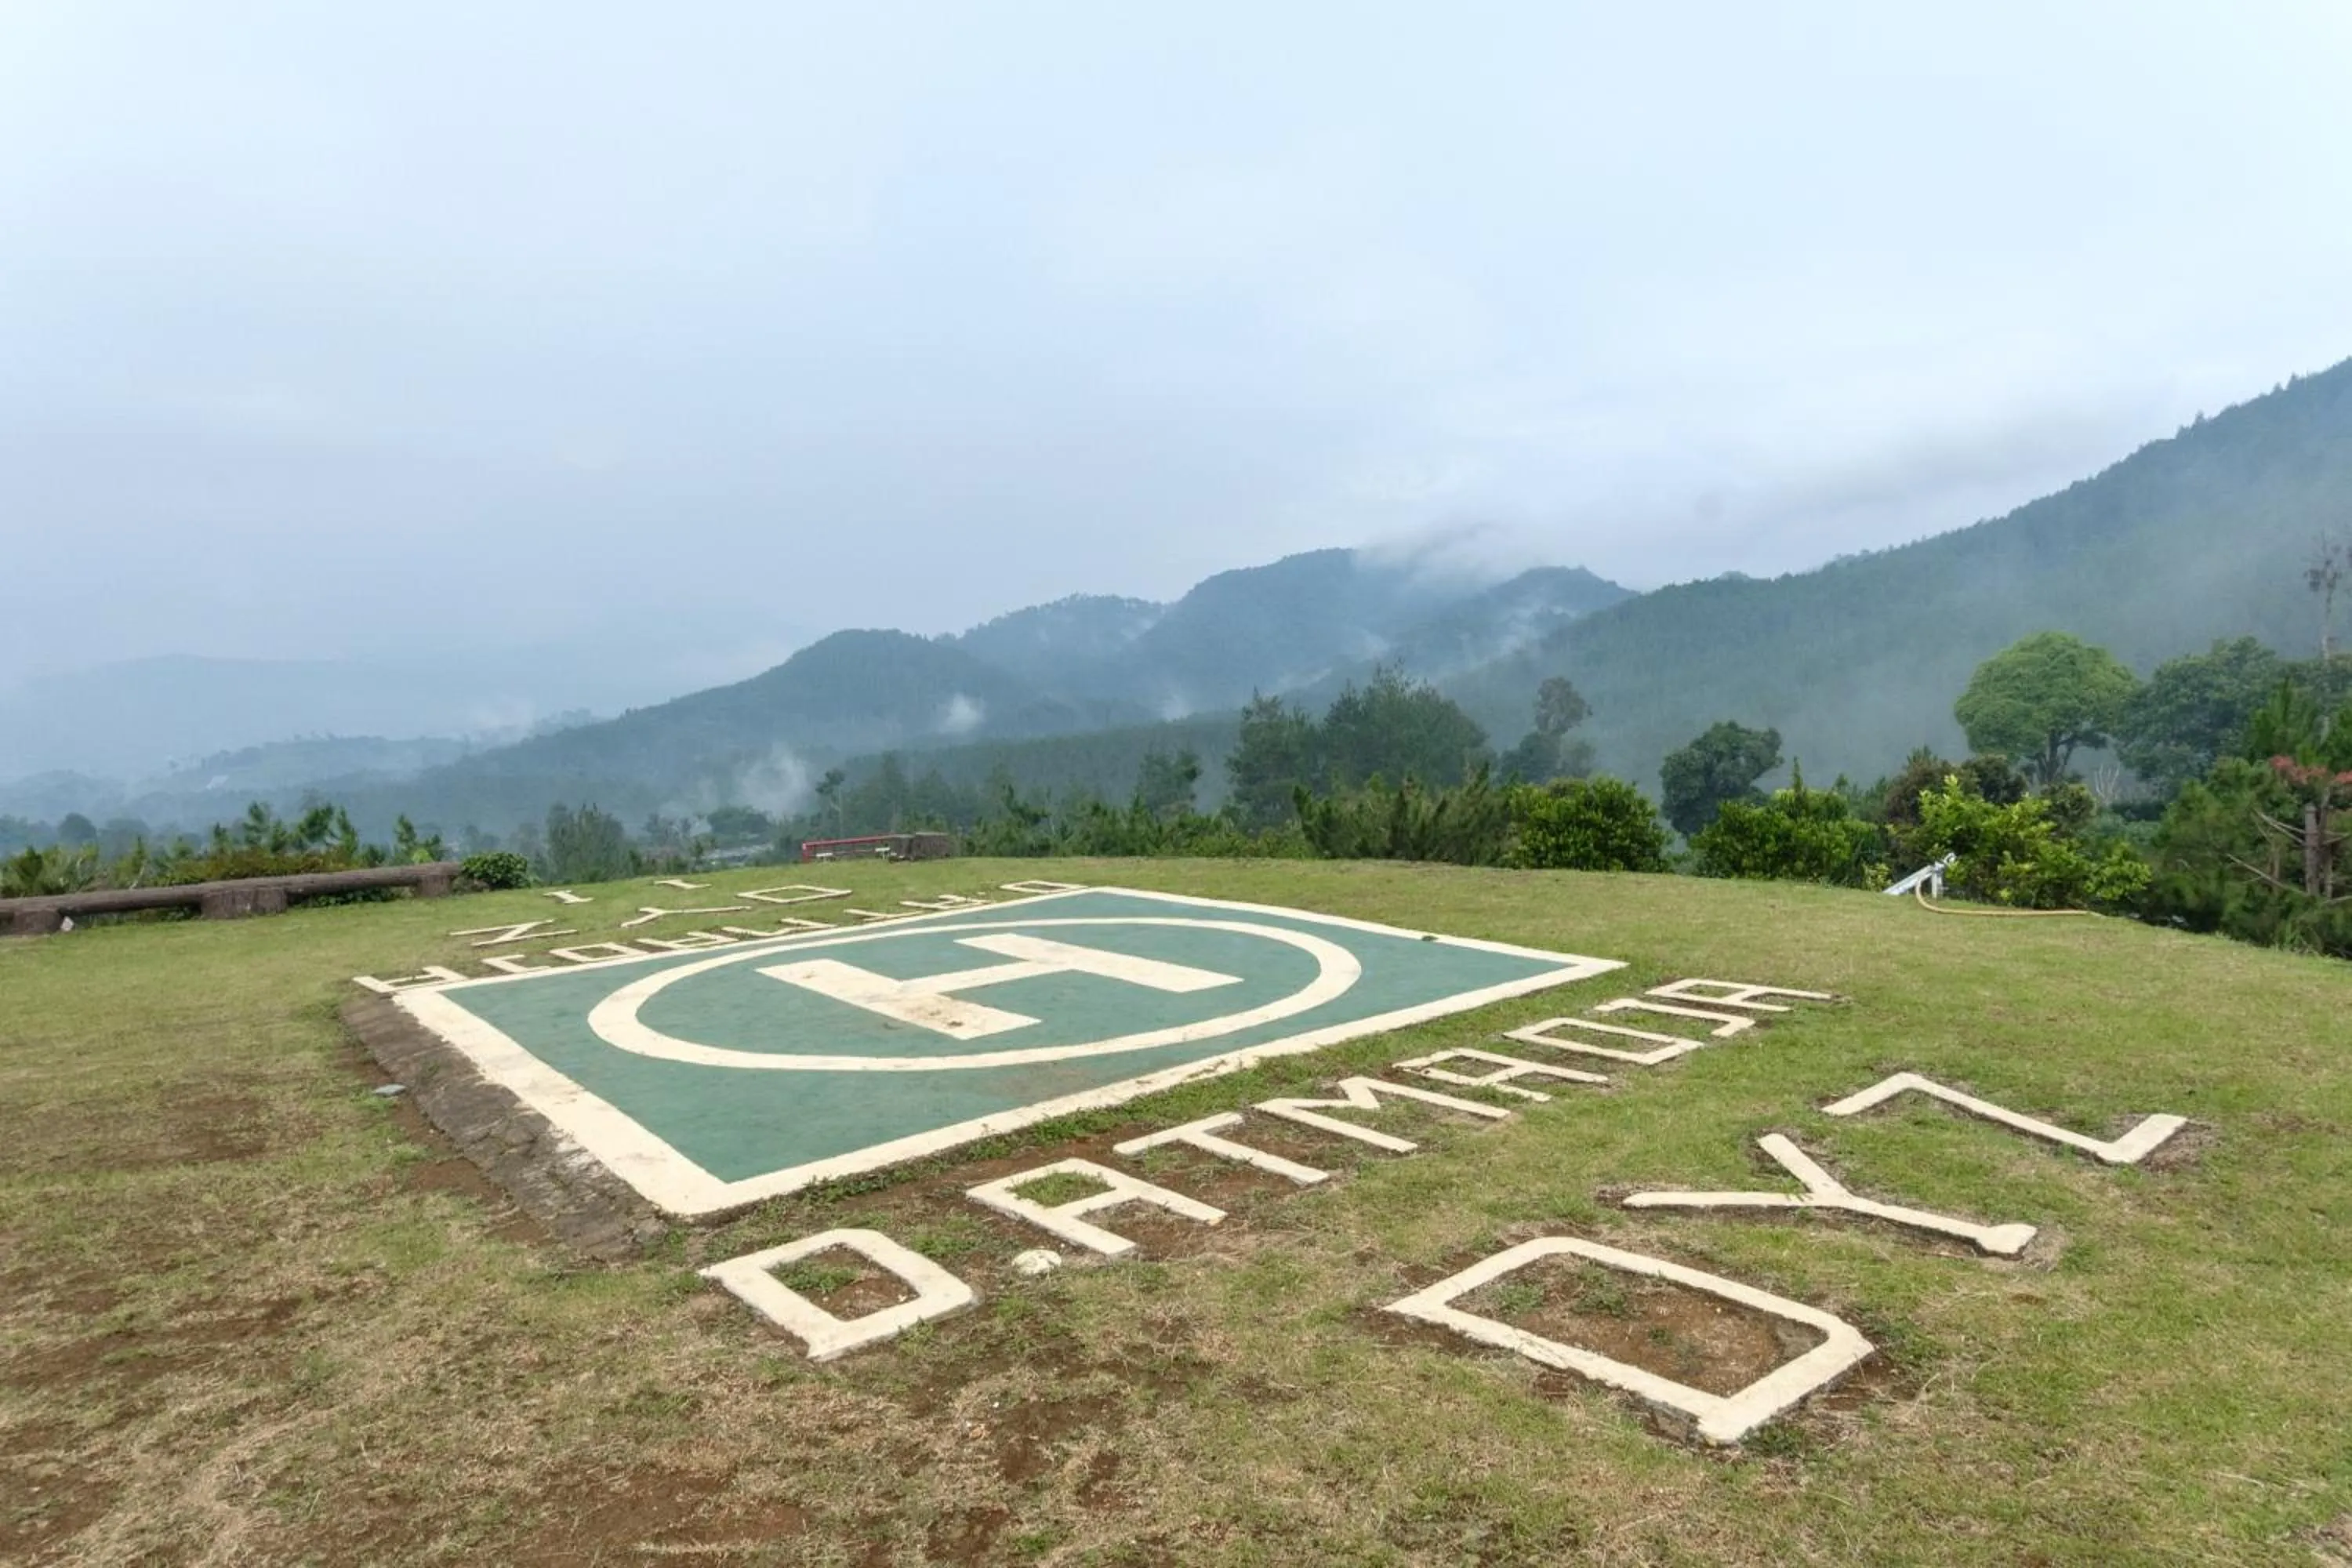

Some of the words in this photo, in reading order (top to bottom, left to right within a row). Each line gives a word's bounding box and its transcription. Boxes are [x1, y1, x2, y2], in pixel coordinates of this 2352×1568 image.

[699, 978, 1833, 1361] D.ATMADJA
[754, 933, 1244, 1040] H
[1383, 1071, 2190, 1444] DYZ
